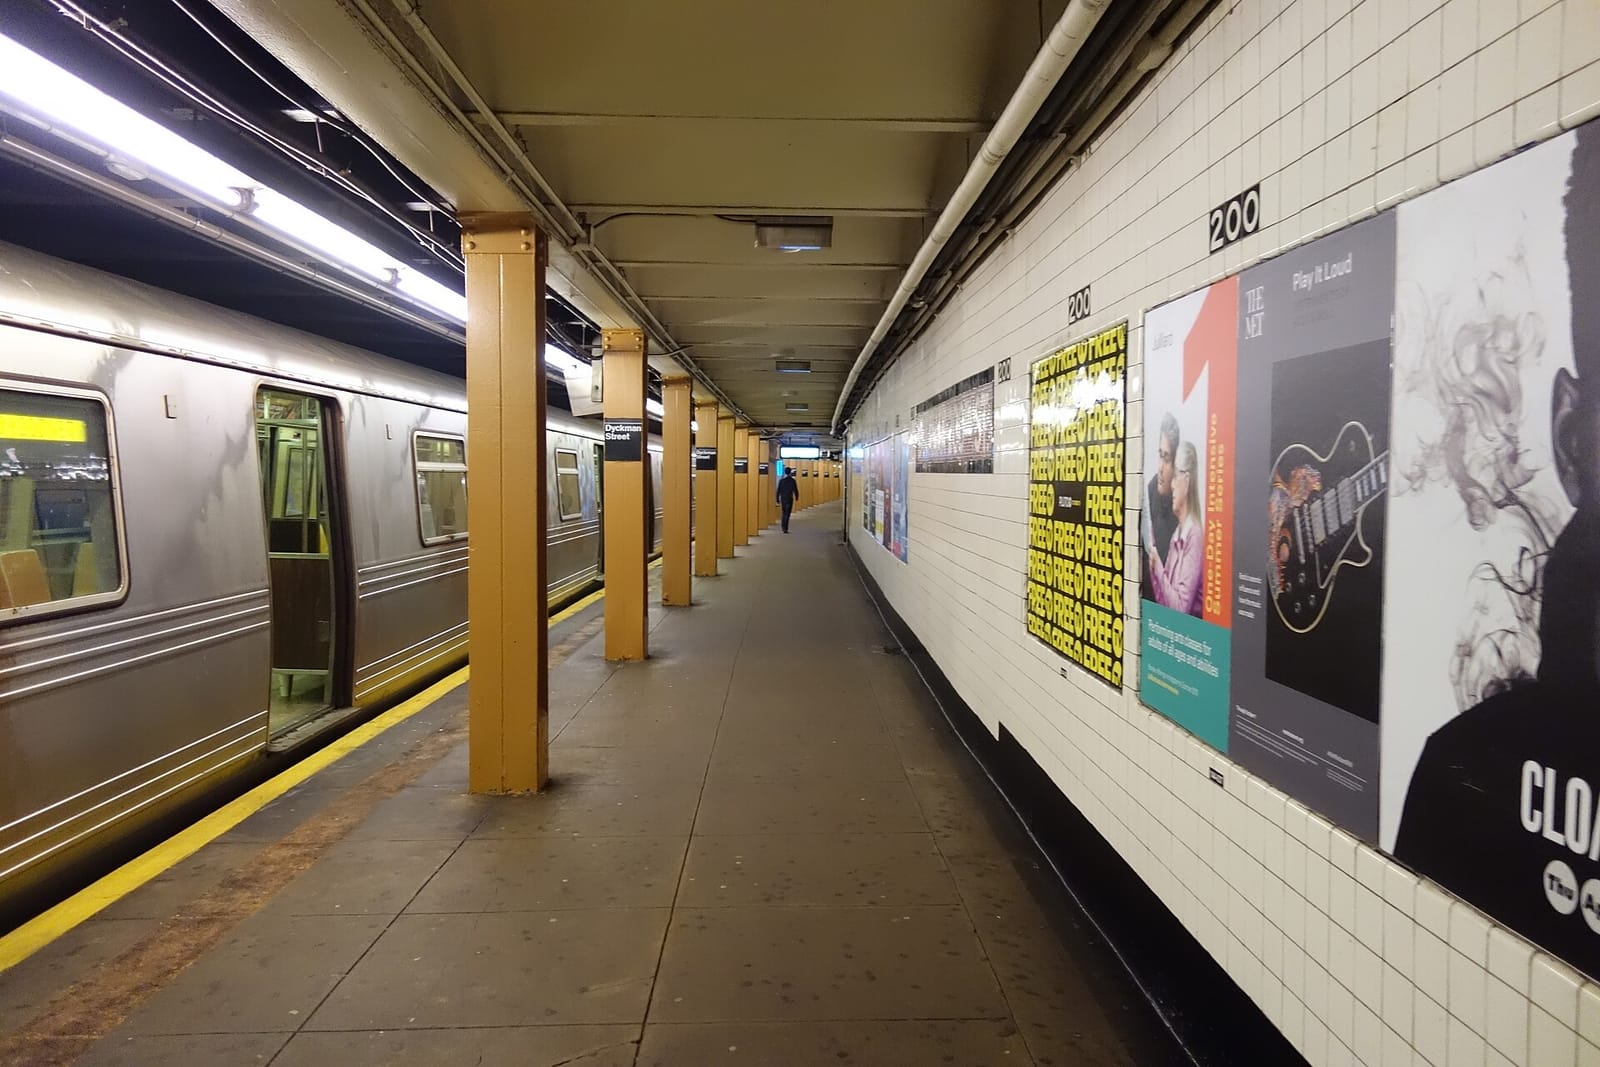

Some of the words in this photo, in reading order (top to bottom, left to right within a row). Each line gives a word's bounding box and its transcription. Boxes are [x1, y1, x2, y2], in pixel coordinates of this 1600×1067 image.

[1210, 190, 1259, 251] 200
[1293, 269, 1313, 291] Play
[1315, 264, 1323, 283] It
[1324, 252, 1352, 280] Loud
[1069, 287, 1090, 324] 200
[1246, 286, 1264, 313] THE
[605, 424, 642, 433] Dyckman
[605, 432, 630, 440] Street
[1055, 448, 1076, 480] FREE
[1087, 445, 1114, 482] FREE
[1208, 413, 1217, 512] Intensive
[1216, 443, 1224, 512] Series
[1086, 487, 1114, 526] FREE
[1054, 520, 1075, 557] FREE
[1086, 526, 1113, 568] FREE
[1053, 556, 1074, 595] FREE
[1085, 566, 1112, 611] FREE
[1206, 519, 1215, 613] One-Day
[1213, 519, 1222, 616] Summer
[1053, 591, 1074, 632] FREE
[1085, 605, 1112, 653] FREE
[1203, 641, 1212, 656] for
